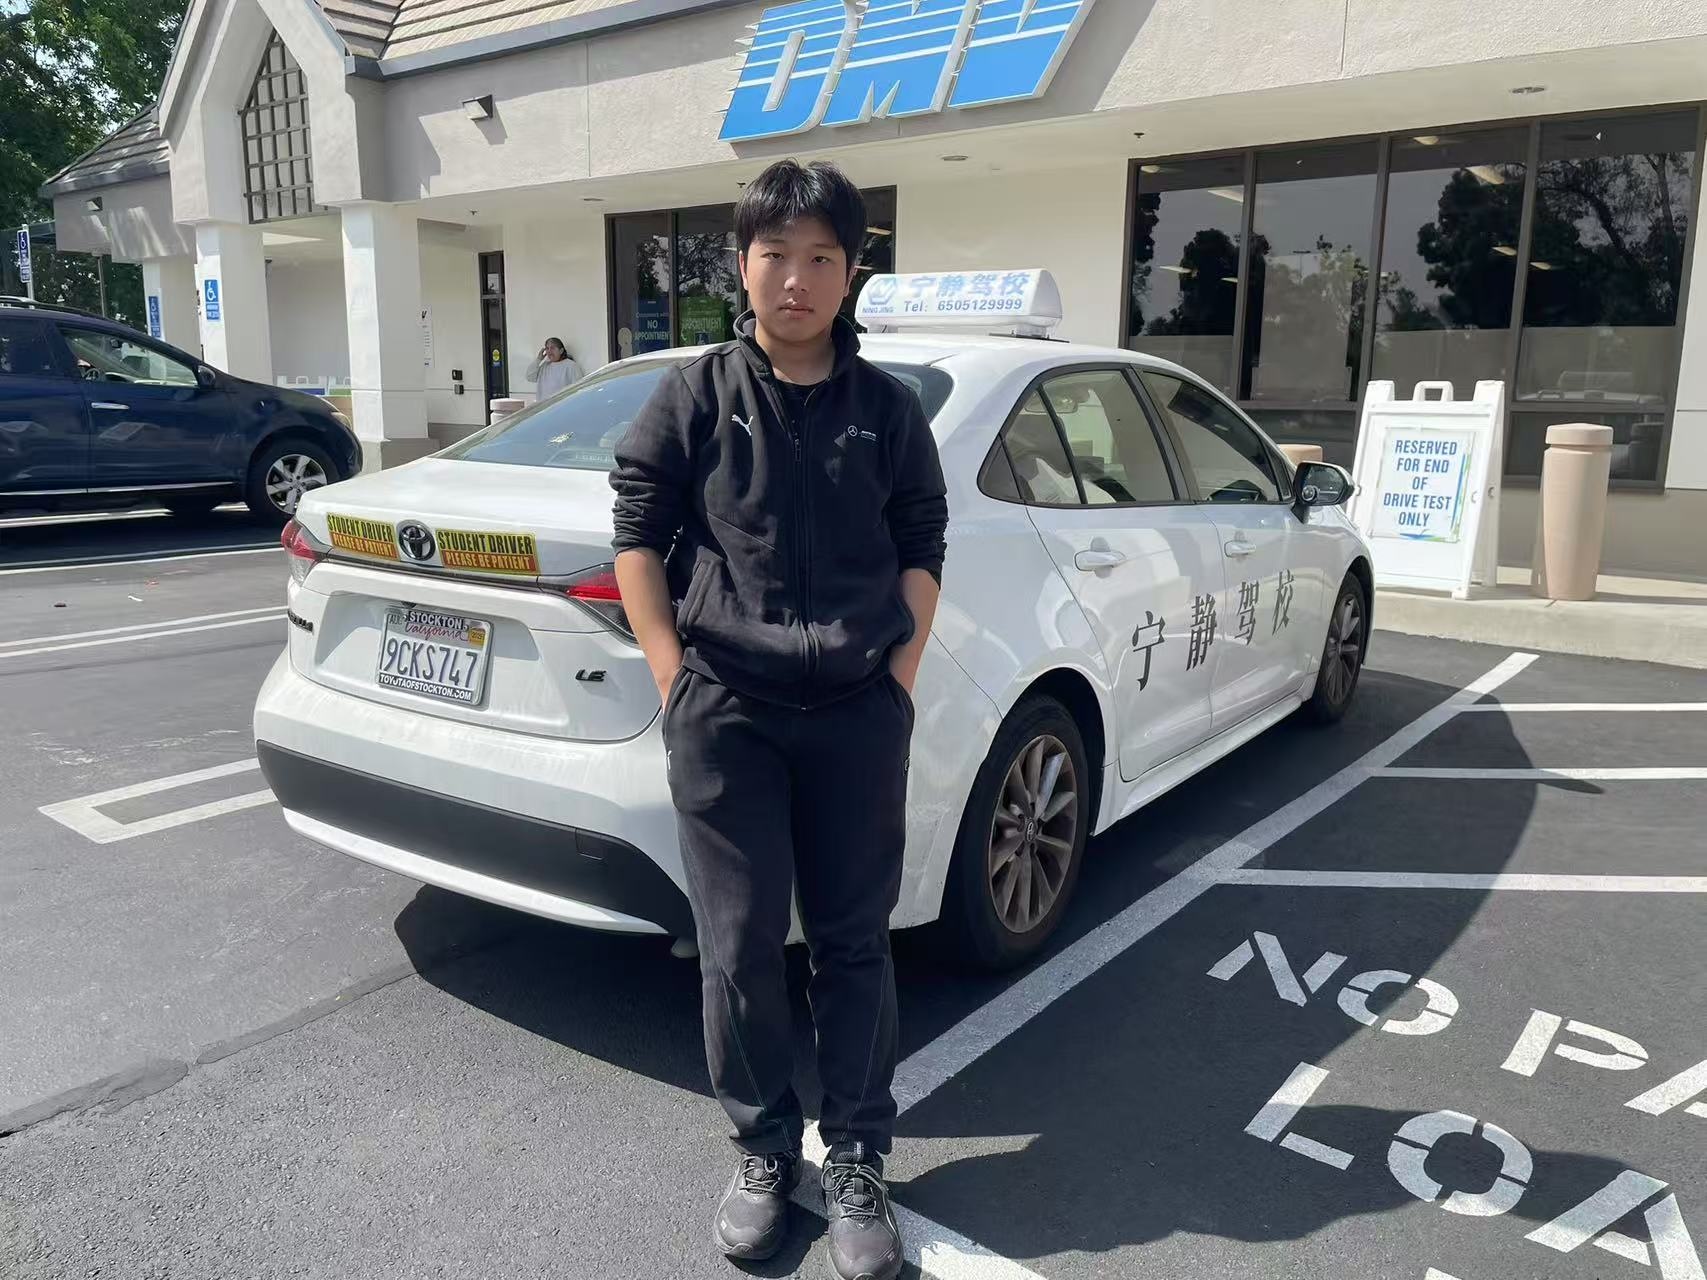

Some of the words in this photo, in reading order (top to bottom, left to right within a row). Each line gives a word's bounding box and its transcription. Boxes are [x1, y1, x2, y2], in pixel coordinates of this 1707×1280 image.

[718, 0, 1097, 142] DMV
[909, 272, 1031, 297] 宁静驾校
[904, 300, 929, 312] Tel:
[938, 299, 1023, 311] 6505129999
[647, 319, 658, 329] NO
[1395, 440, 1457, 455] RESERVED
[1396, 458, 1420, 472] FOR
[1424, 459, 1449, 473] END
[1412, 476, 1428, 490] OF
[1383, 493, 1419, 508] DRIVE
[1423, 495, 1452, 510] TEST
[327, 514, 360, 537] STUDENT
[360, 521, 393, 543] DRIVER
[1398, 511, 1430, 527] ONLY
[332, 533, 355, 549] PLEASE
[352, 537, 363, 551] BE
[361, 539, 394, 557] PATIENT
[438, 531, 487, 552] STUDENT
[488, 534, 533, 555] DRIVER
[446, 551, 477, 567] PLEASE
[478, 554, 491, 567] BE
[491, 555, 530, 570] PATIENT
[409, 611, 461, 630] STOCKTON
[1132, 569, 1294, 691] 宁静驾校
[384, 637, 478, 688] 9CKS747
[575, 669, 606, 682] LE
[1207, 930, 1459, 1035] NO
